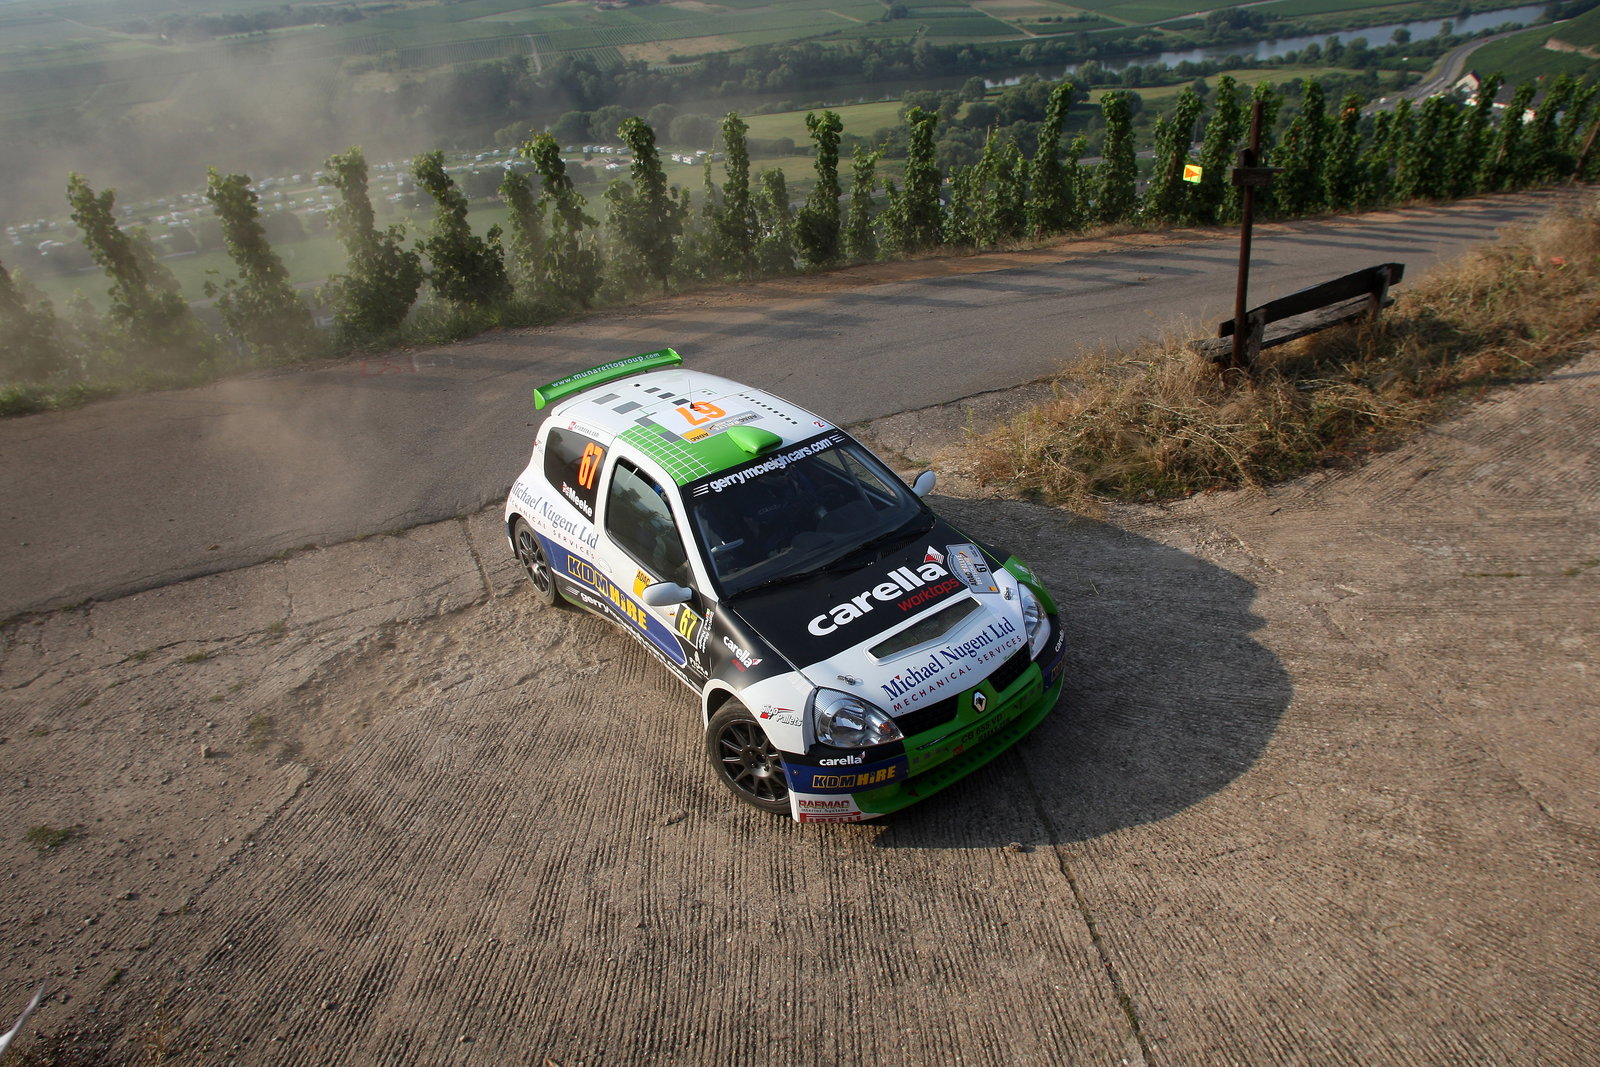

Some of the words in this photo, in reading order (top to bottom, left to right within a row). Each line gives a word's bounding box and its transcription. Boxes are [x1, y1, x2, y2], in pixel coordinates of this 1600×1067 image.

[551, 352, 660, 388] www.munarettogroup.com
[675, 401, 726, 426] 67
[578, 442, 604, 490] 67
[709, 437, 832, 493] gerrymcveighcars.com
[569, 486, 593, 517] Meeke
[539, 501, 578, 536] Nugent
[578, 526, 600, 550] Ltd
[552, 530, 596, 560] SERVICES
[567, 554, 609, 597] KDM
[973, 562, 988, 573] 67
[807, 563, 949, 637] carella
[897, 577, 961, 612] worktops
[680, 607, 698, 641] 67
[723, 635, 753, 668] carella
[881, 654, 945, 702] Michael
[939, 630, 993, 664] Nugent
[988, 616, 1016, 639] Ltd
[893, 664, 972, 712] MECHANICAL
[977, 635, 1022, 664] SERVICES
[819, 755, 862, 766] carella
[812, 774, 855, 788] KDM
